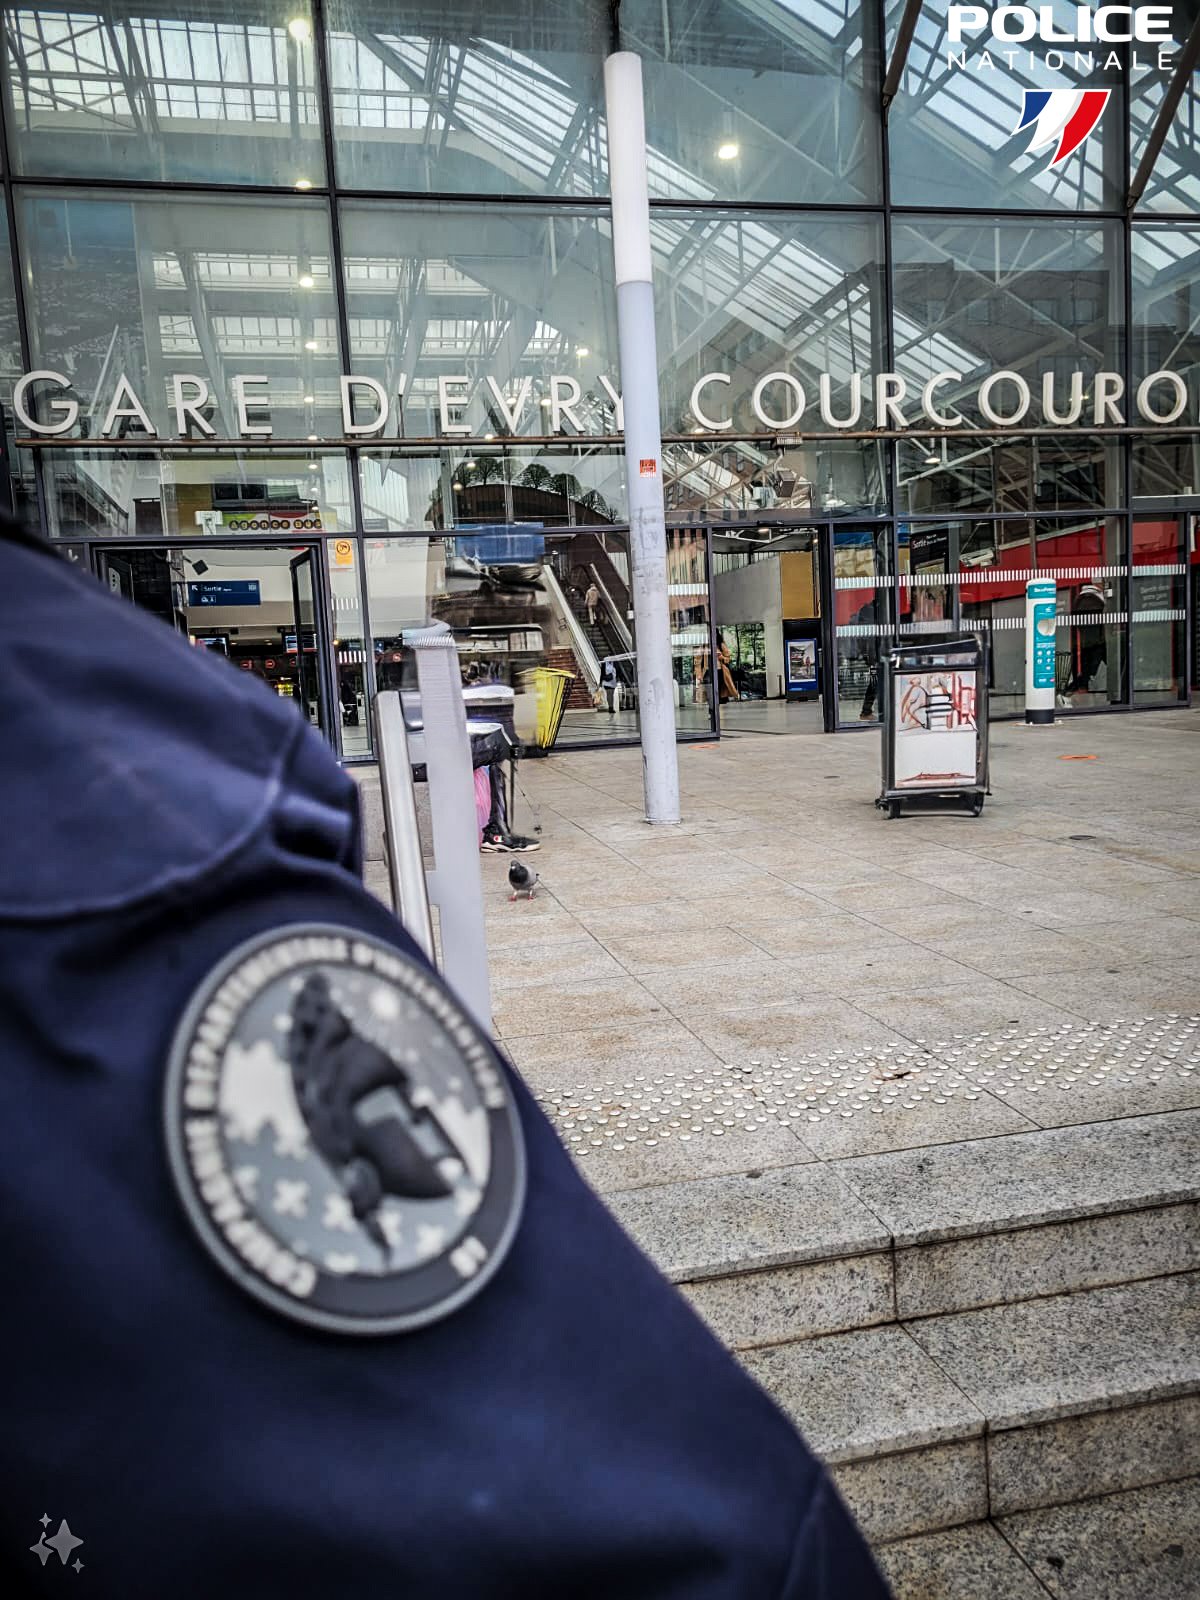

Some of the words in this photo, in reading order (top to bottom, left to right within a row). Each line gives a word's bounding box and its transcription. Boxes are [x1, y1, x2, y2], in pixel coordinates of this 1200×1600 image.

[13, 370, 273, 436] GARE
[340, 373, 625, 434] D'EVRY
[691, 369, 1200, 431] COURCOURO
